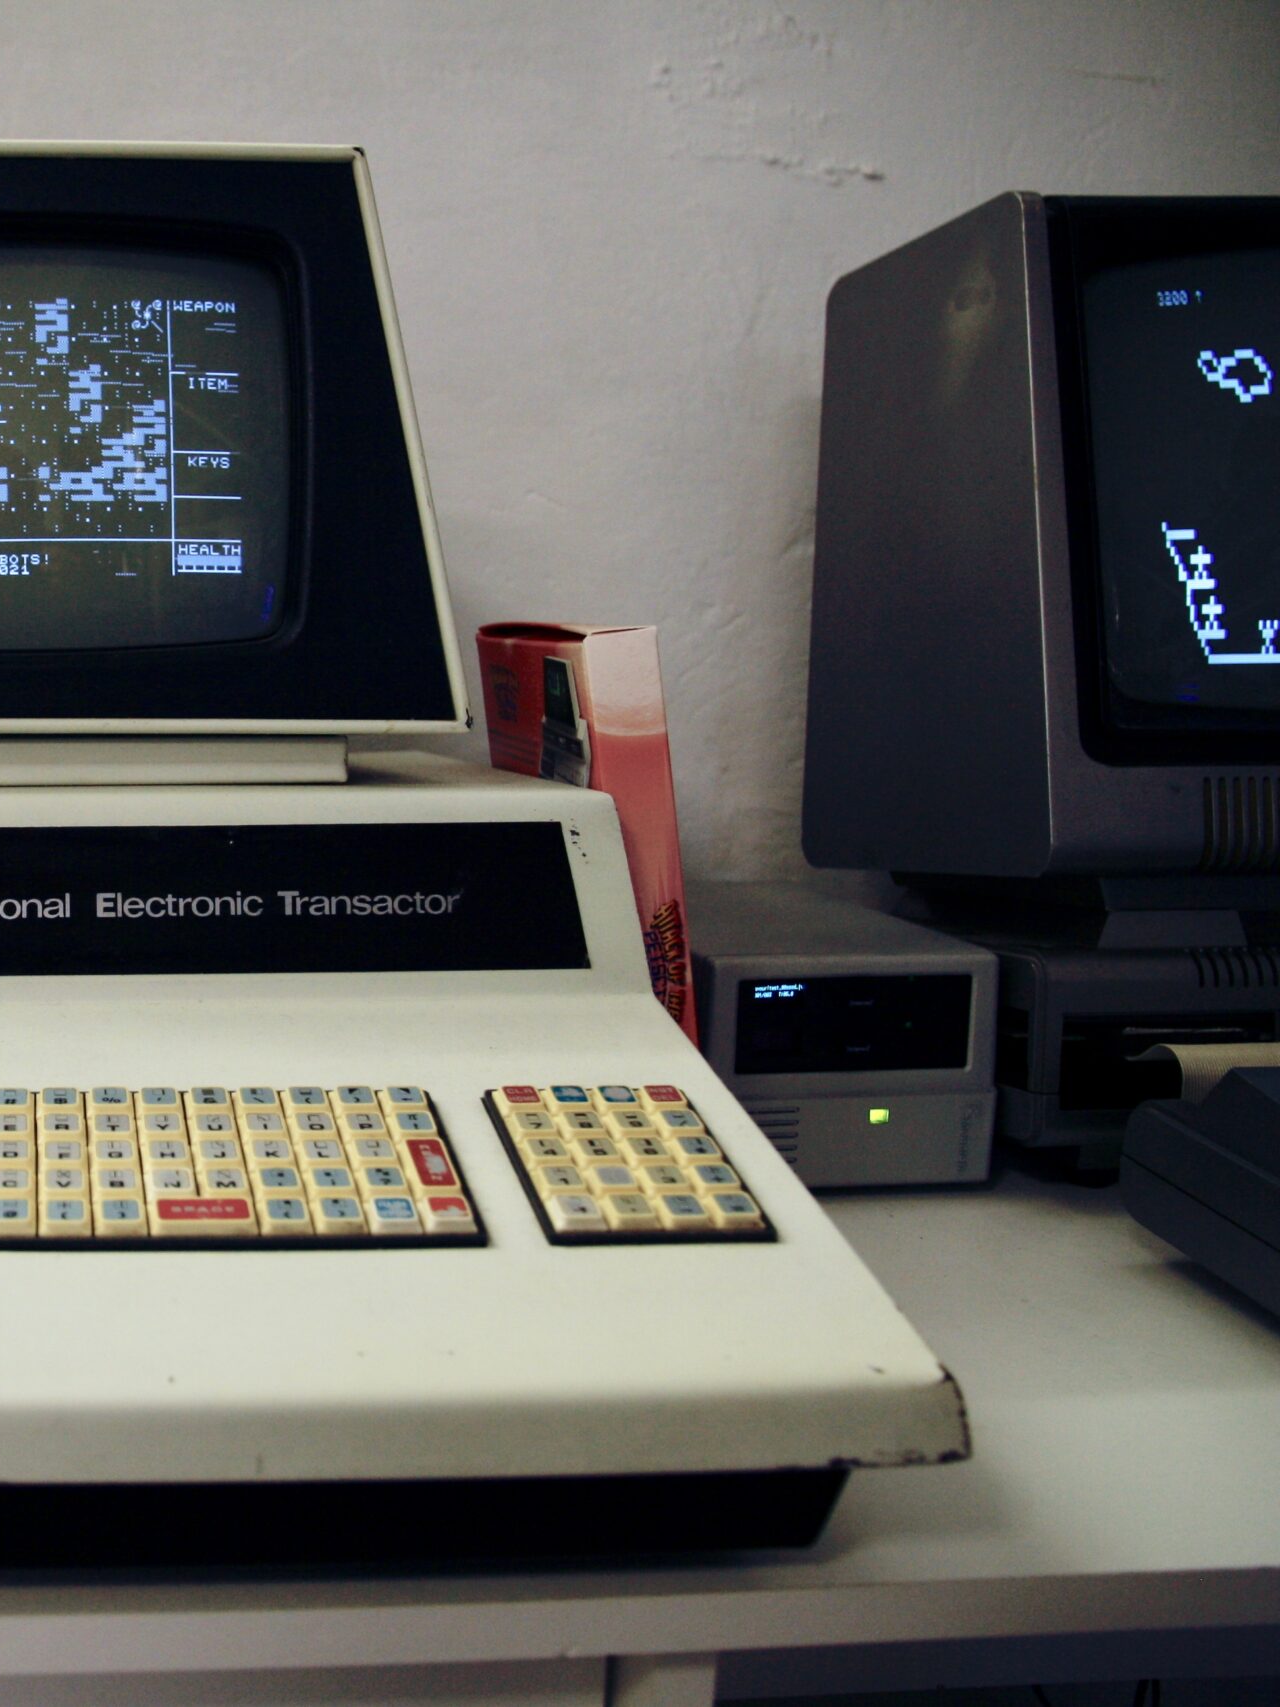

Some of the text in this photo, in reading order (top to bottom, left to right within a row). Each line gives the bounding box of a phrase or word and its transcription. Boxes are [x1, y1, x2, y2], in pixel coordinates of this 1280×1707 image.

[173, 300, 236, 313] WEAPON
[188, 377, 228, 390] ITEM
[187, 456, 231, 469] KEYS
[178, 544, 241, 556] HEALTH
[95, 891, 264, 919] Electronic
[276, 890, 460, 917] Transactor
